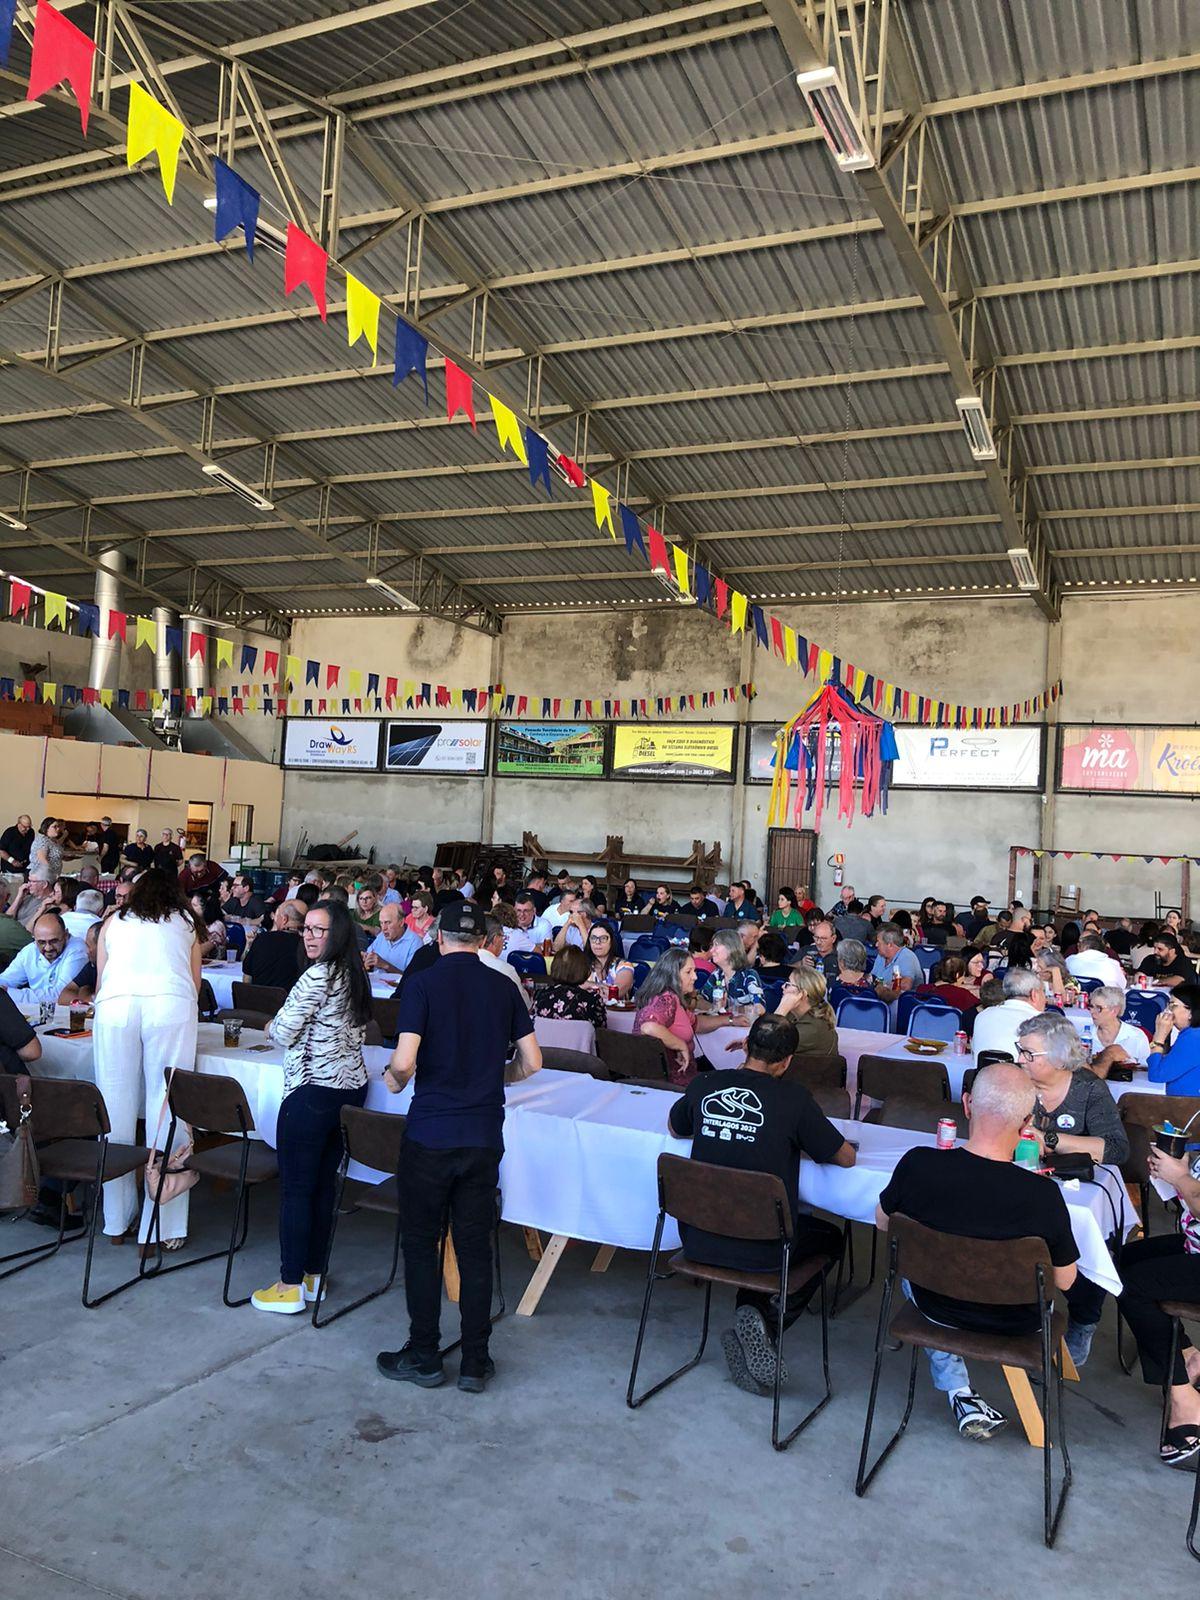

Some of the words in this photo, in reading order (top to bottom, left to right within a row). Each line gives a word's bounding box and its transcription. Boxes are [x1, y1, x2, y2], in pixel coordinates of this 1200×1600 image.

[310, 739, 332, 749] Draw
[930, 737, 1000, 757] PERFECT
[1081, 746, 1130, 769] ma
[703, 1118, 739, 1130] INTERLAGOS
[740, 1124, 756, 1133] 2022
[736, 1133, 755, 1142] BYD
